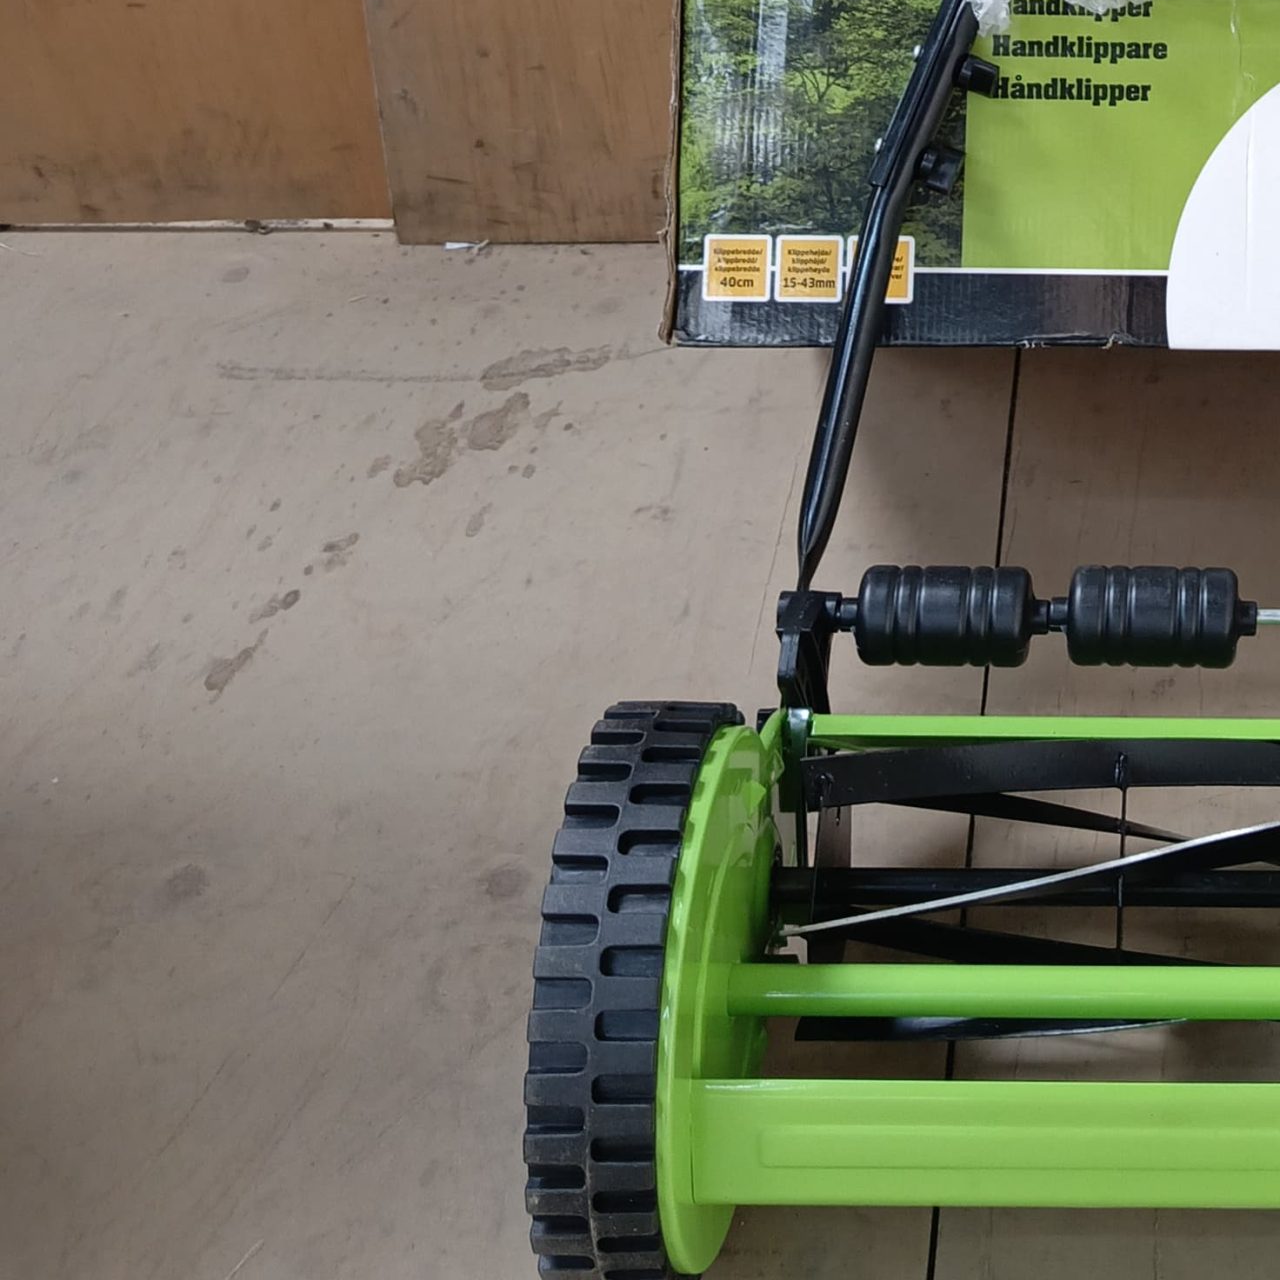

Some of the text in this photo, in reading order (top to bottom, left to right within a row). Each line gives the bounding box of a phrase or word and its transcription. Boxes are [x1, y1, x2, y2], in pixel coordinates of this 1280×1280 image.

[992, 34, 1168, 64] Handklippare
[992, 74, 1152, 106] Håndklipper
[720, 276, 754, 288] 40cm
[783, 277, 836, 289] 15-43mm
